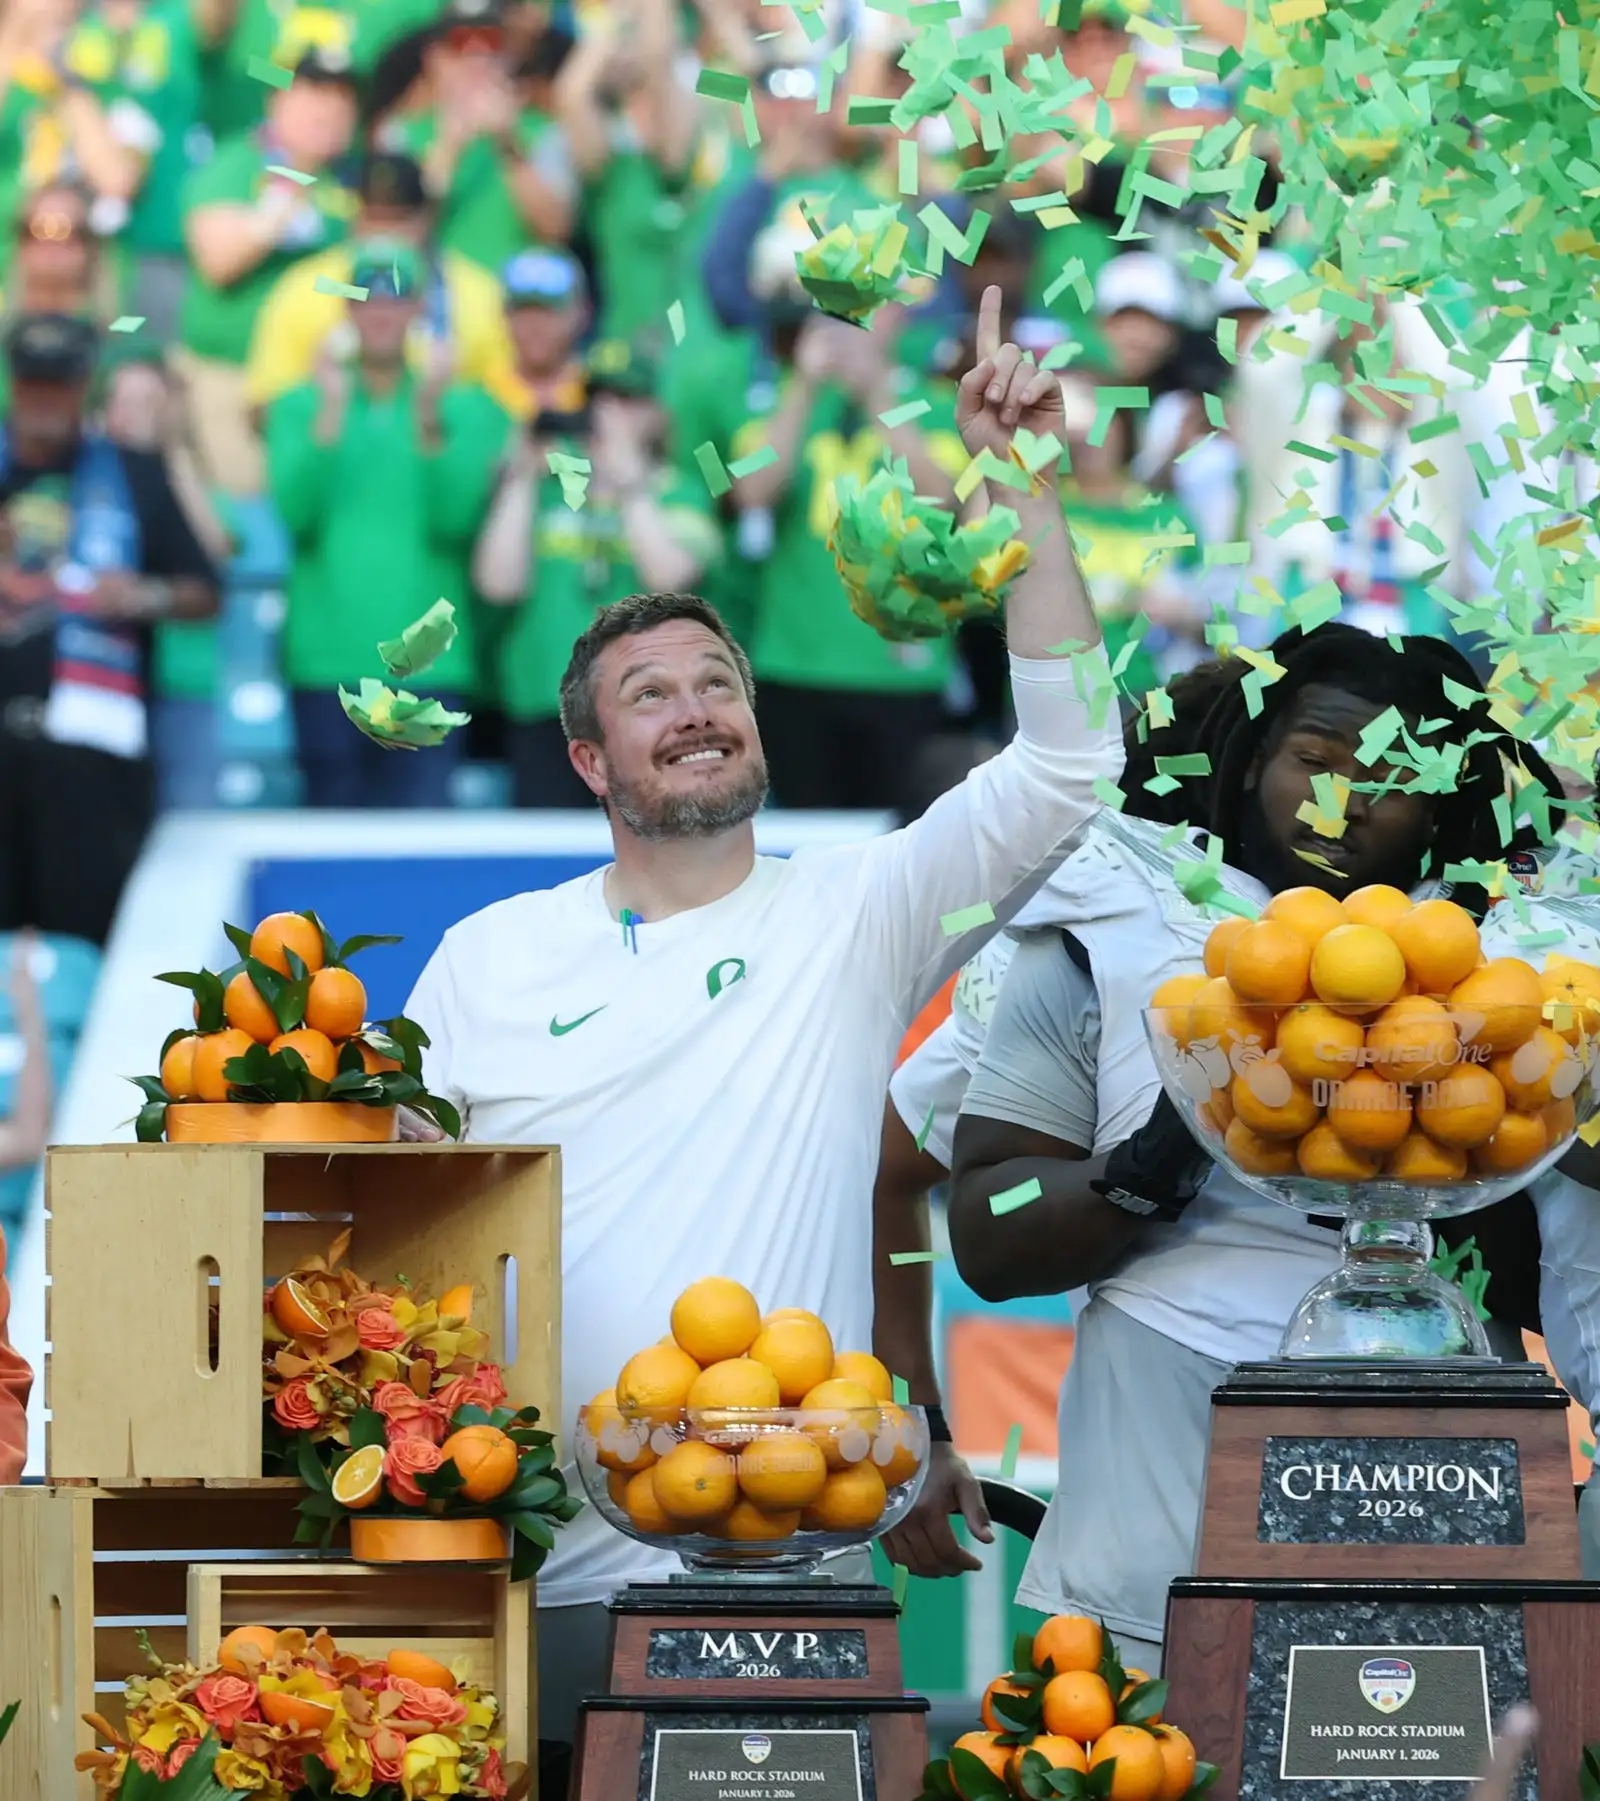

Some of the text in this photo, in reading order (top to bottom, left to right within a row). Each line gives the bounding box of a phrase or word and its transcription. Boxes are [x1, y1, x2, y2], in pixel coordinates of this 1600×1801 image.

[1280, 1464, 1501, 1501] CHAMPION
[1358, 1500, 1424, 1517] 2026
[698, 1632, 818, 1659] MVP
[736, 1663, 781, 1677] 2026
[1310, 1725, 1465, 1737] HARD ROCK STADIUM
[1336, 1749, 1396, 1762] JANUARY
[1411, 1749, 1440, 1760] 2026
[688, 1770, 825, 1781] HARD ROCK STADIUM
[718, 1789, 762, 1799] JANUARY
[773, 1789, 795, 1798] 2026
